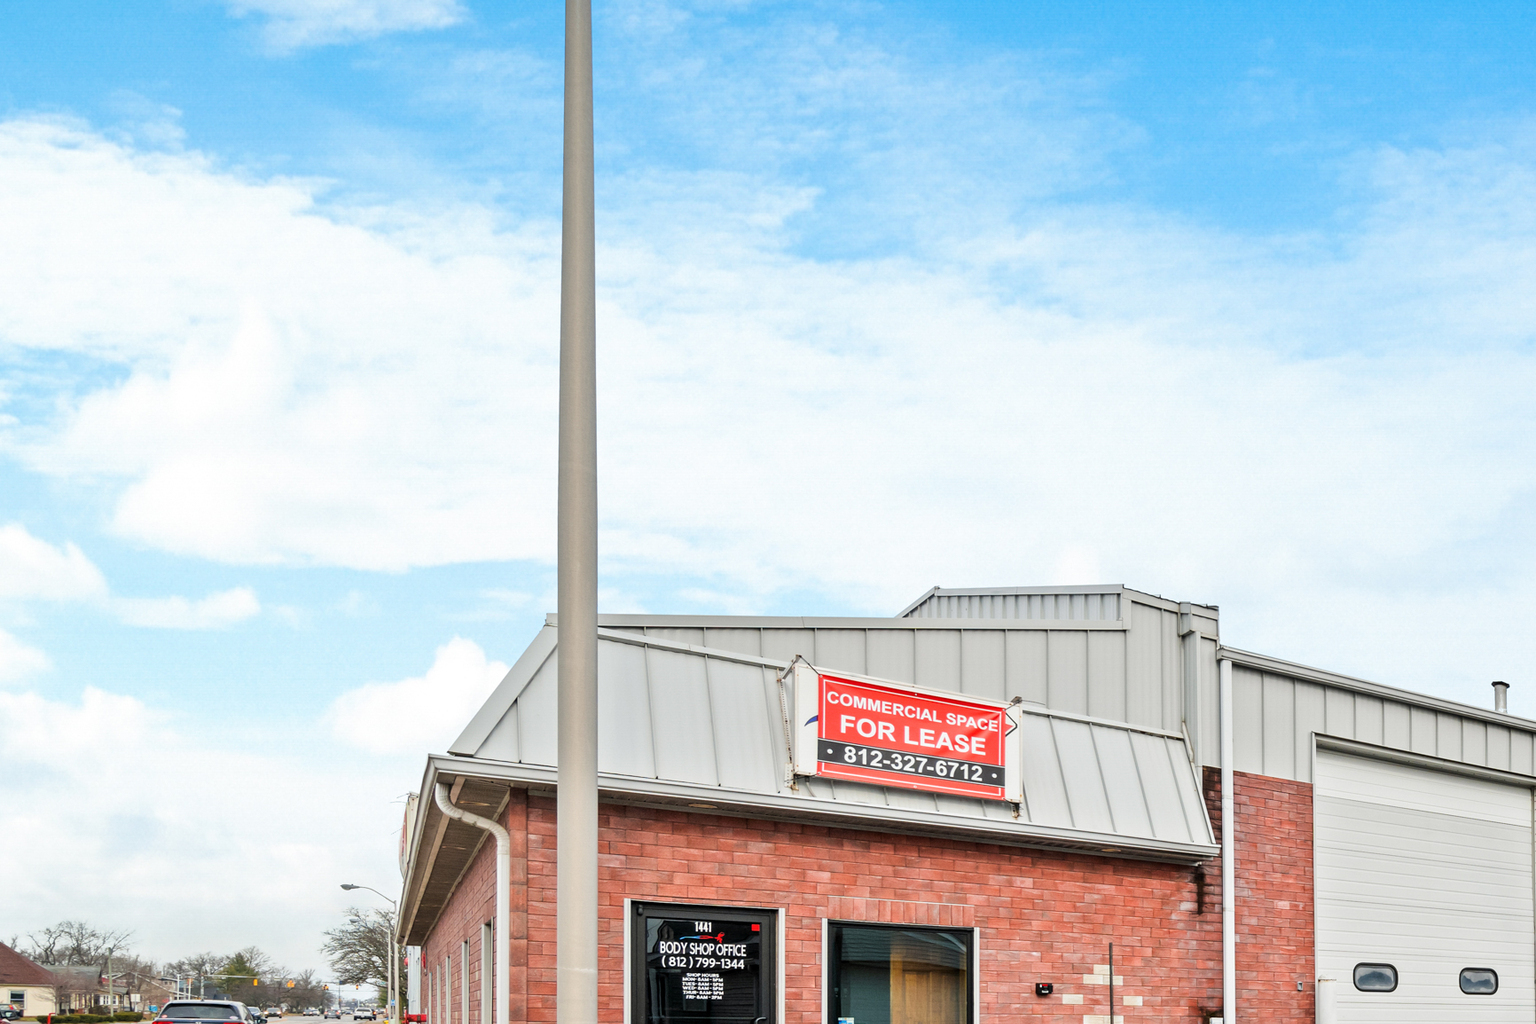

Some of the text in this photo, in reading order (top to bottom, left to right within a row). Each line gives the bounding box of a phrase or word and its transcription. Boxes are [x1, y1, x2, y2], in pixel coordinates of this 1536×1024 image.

[827, 691, 998, 732] COMMERCIAL SPACE
[840, 714, 987, 756] FOR LEASE
[843, 746, 983, 782] 812-327-6712
[694, 921, 712, 933] 1441
[659, 941, 747, 957] BODY SHOP OFFICE
[695, 957, 745, 970] 799-1344
